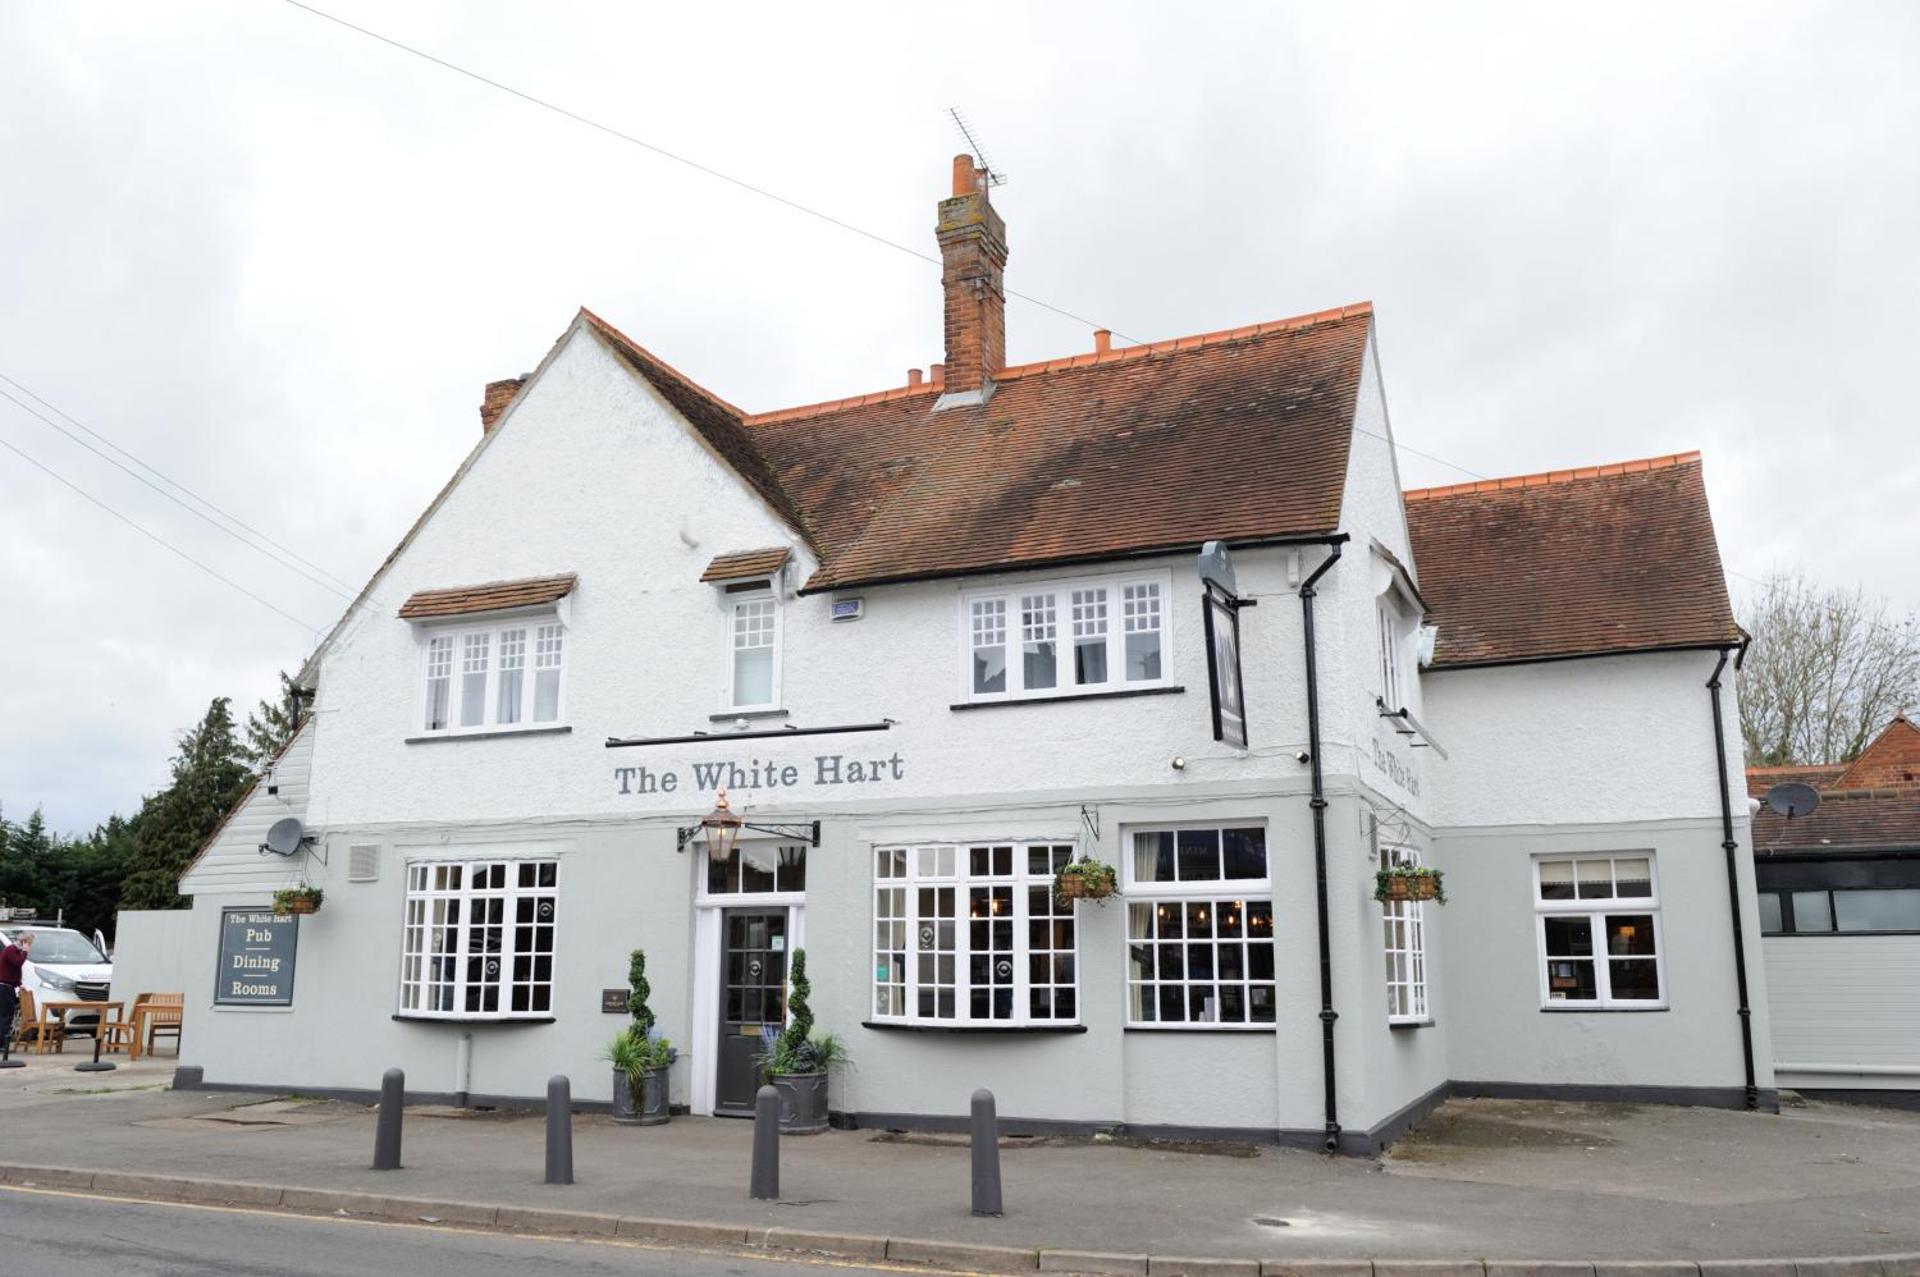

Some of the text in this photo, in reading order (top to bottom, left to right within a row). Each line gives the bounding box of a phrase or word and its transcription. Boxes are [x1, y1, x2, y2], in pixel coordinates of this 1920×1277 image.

[615, 752, 904, 794] The White Hart
[230, 914, 246, 924] The
[248, 914, 272, 923] White
[245, 928, 272, 942] Pub
[232, 955, 280, 972] Dining
[232, 981, 277, 996] Rooms
